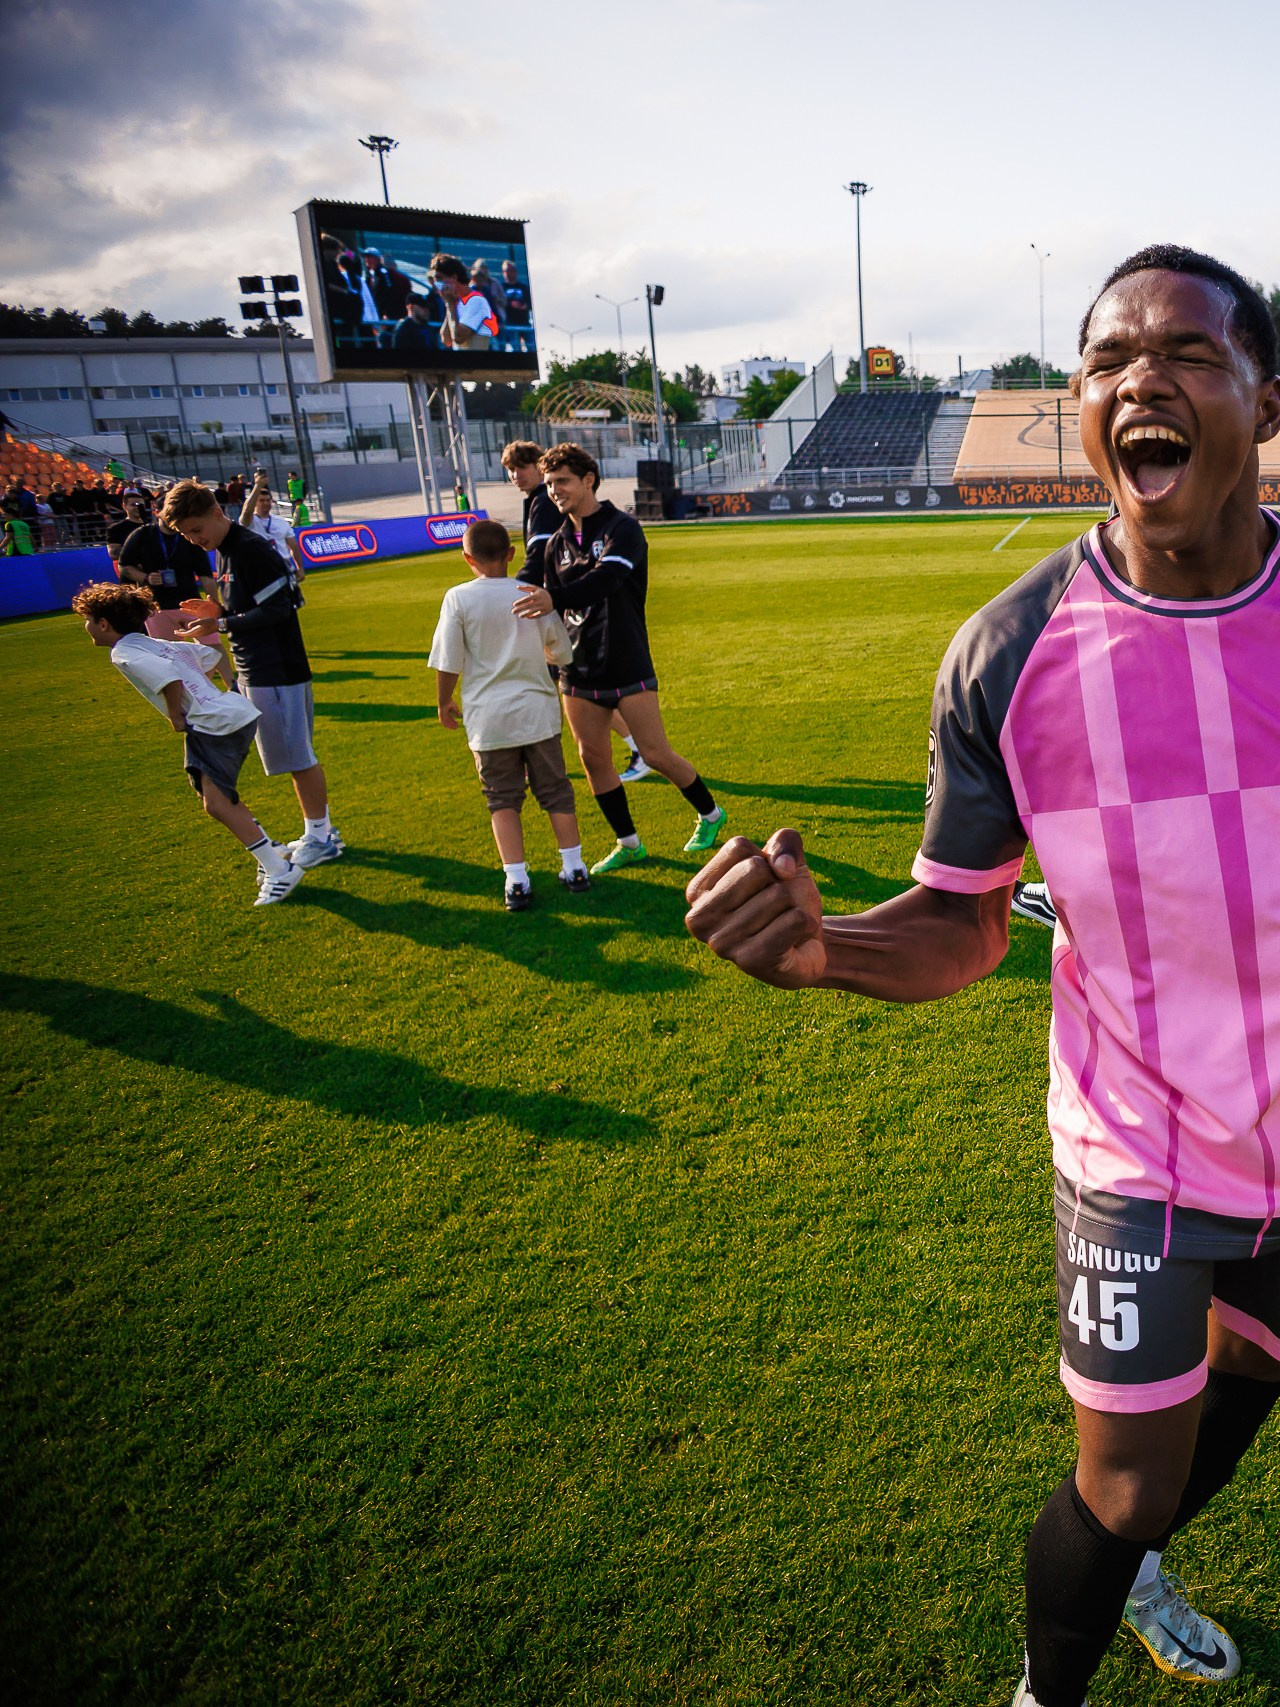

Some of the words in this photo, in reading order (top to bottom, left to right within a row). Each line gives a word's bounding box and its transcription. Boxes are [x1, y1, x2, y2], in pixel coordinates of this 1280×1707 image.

[875, 357, 889, 367] D1
[429, 520, 468, 539] Winline
[305, 533, 359, 555] Winline
[1068, 1274, 1140, 1351] 45
